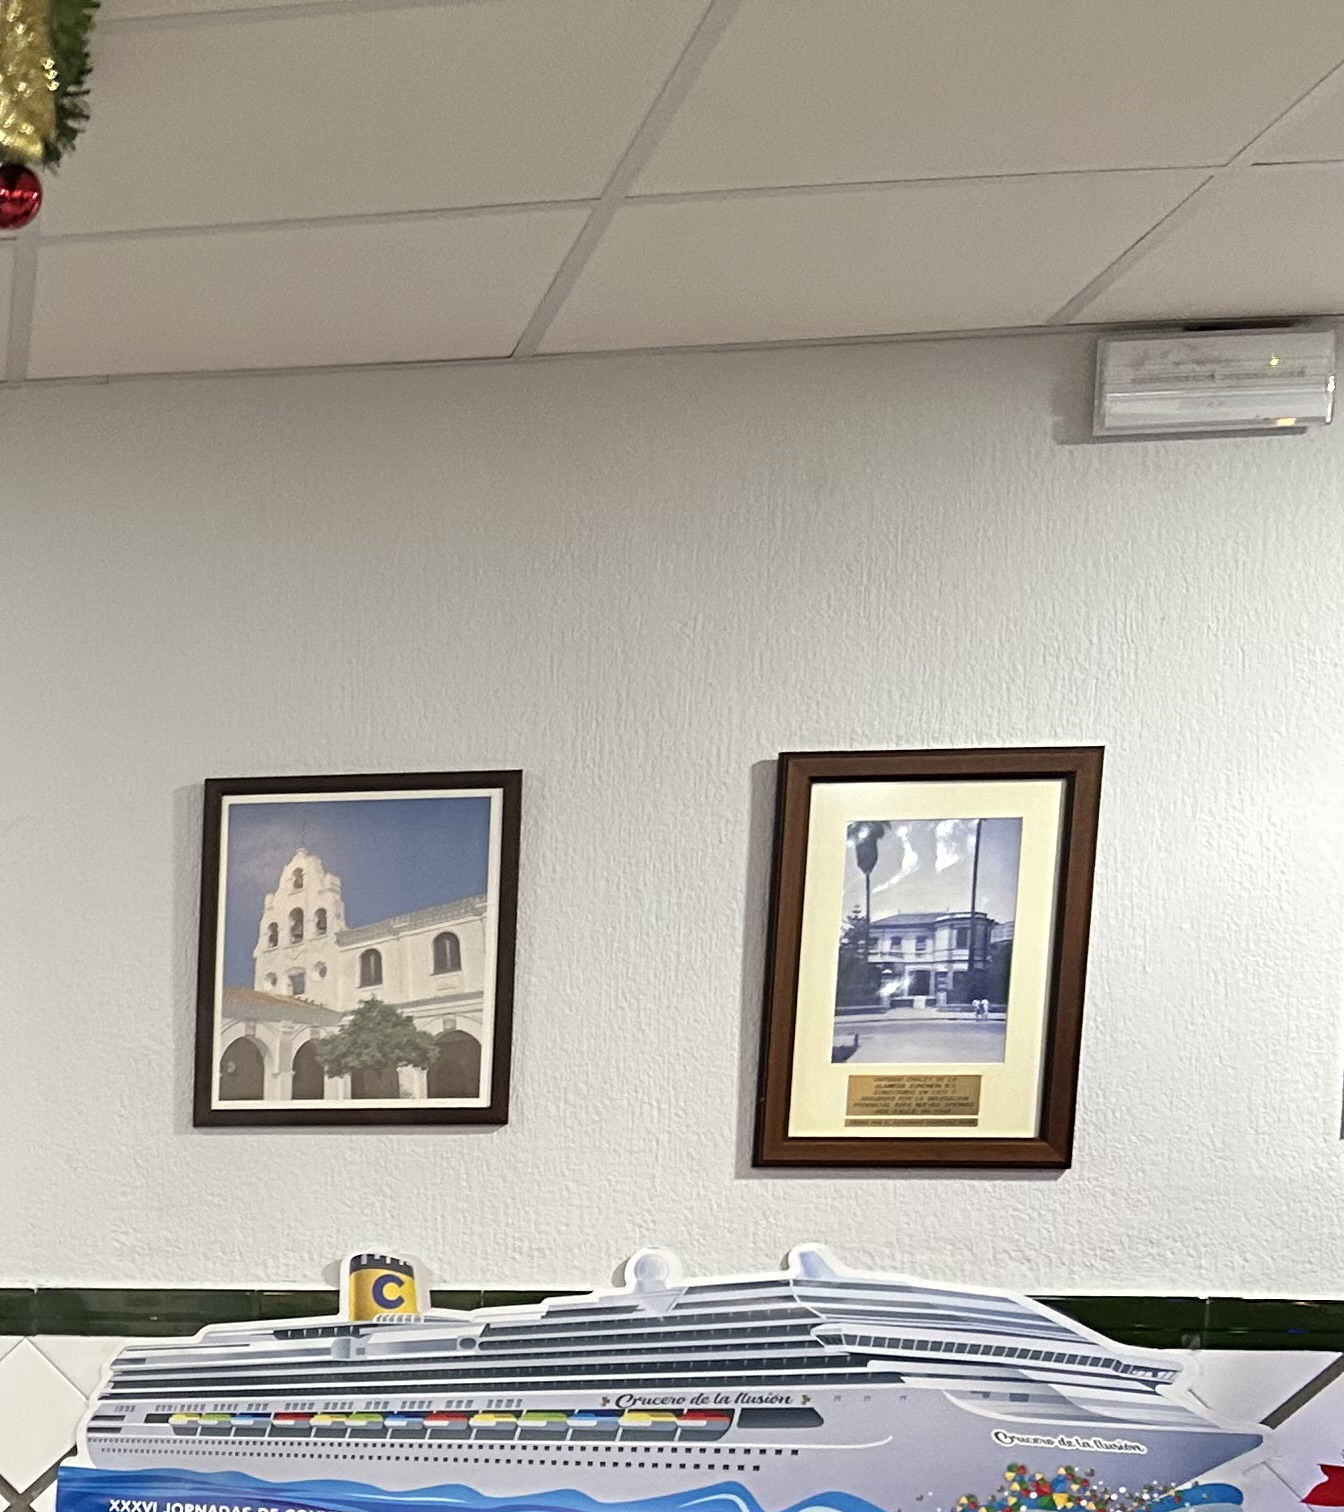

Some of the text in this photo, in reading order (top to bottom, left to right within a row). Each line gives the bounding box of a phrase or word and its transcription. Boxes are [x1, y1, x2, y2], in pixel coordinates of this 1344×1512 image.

[371, 1273, 405, 1309] C
[615, 1391, 793, 1409] Crucero de la Ilusión
[994, 1431, 1055, 1446] Crucero
